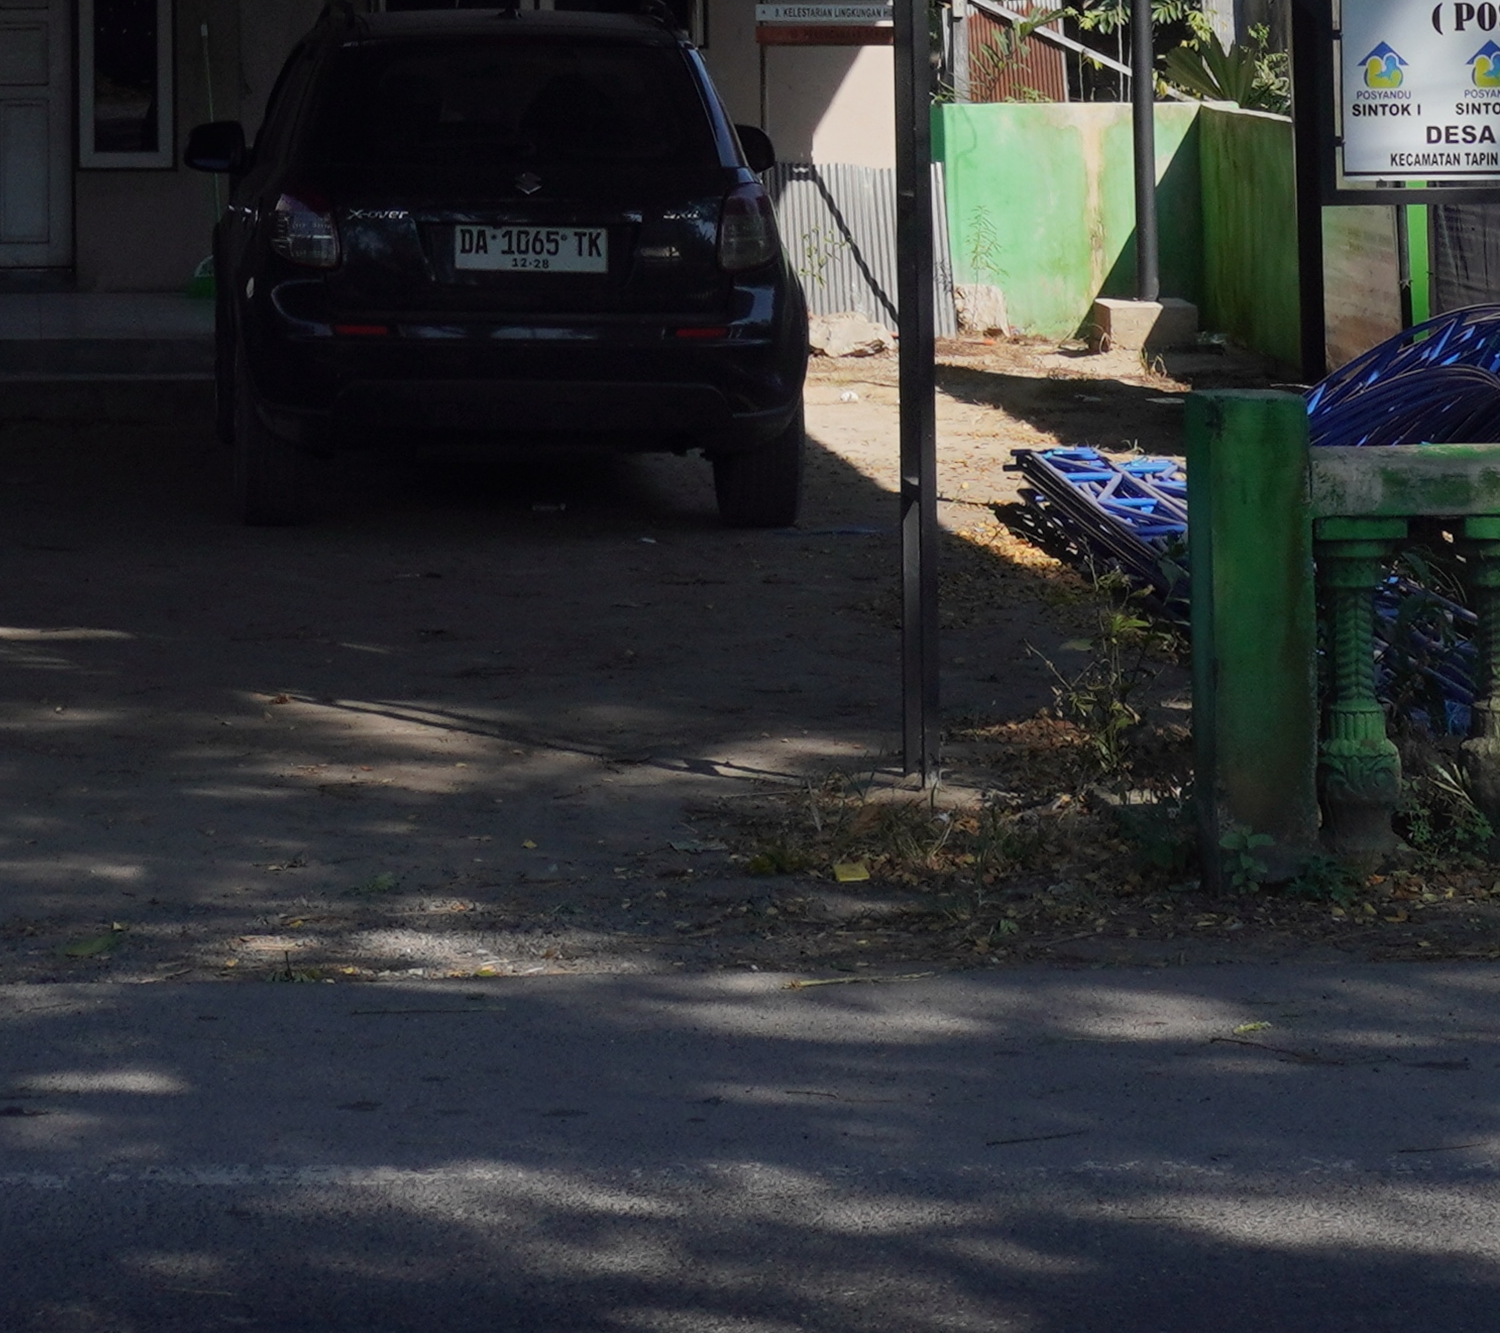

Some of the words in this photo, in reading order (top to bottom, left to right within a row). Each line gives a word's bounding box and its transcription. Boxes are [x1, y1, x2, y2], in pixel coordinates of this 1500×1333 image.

[1356, 90, 1411, 100] POSYANDU
[1352, 103, 1412, 117] SINTOK
[1426, 125, 1496, 144] DESA
[1390, 152, 1461, 166] KECAMATAN
[1465, 152, 1498, 166] TAPIN
[460, 230, 488, 254] DA
[502, 230, 559, 255] 1065
[574, 231, 602, 256] TK
